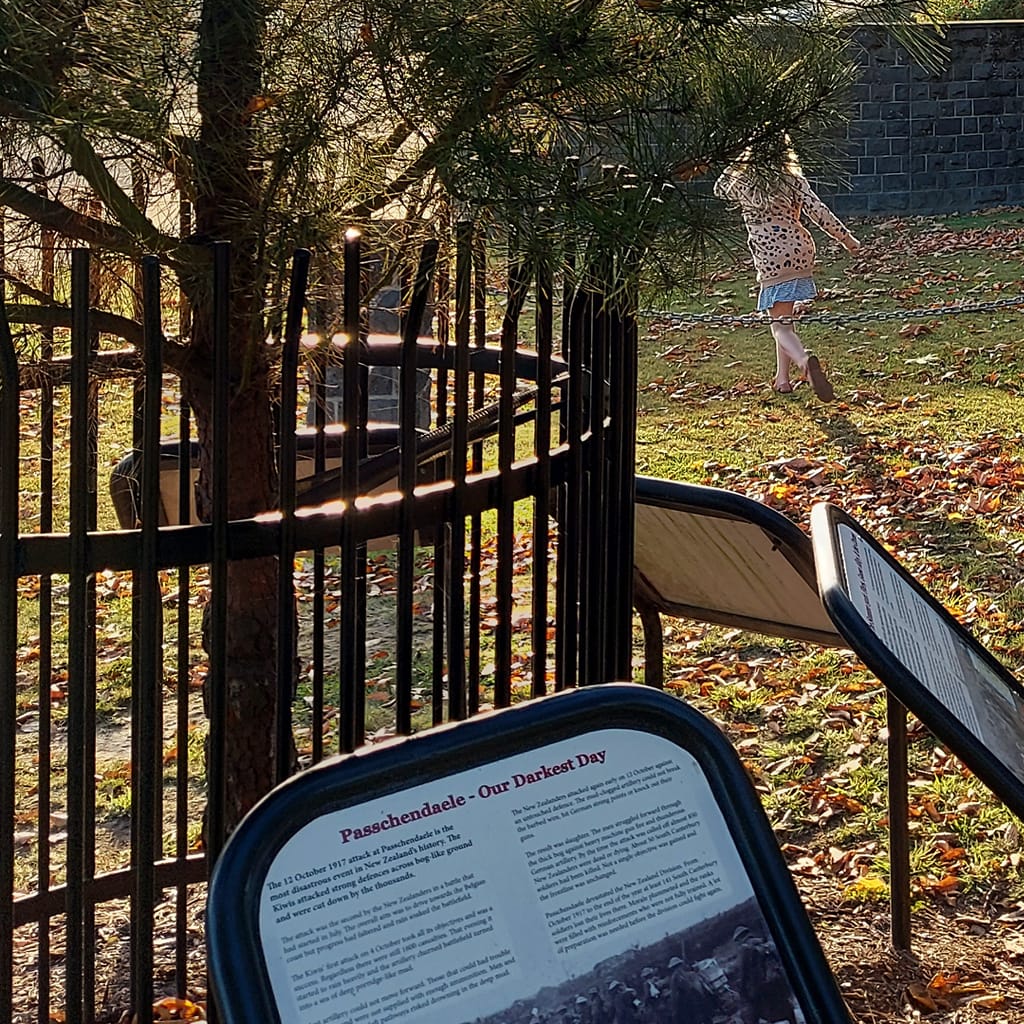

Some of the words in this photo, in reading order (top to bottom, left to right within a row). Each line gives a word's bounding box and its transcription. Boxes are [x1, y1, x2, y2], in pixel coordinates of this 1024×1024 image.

[338, 794, 466, 843] Passchendaele
[476, 782, 511, 799] Our
[512, 760, 575, 788] Darkest
[576, 751, 609, 768] Day
[266, 880, 282, 890] The
[283, 875, 293, 884] 12
[293, 866, 326, 881] October
[328, 858, 346, 870] 1917
[348, 850, 371, 863] attack
[380, 831, 433, 852] Passchendaele
[441, 824, 454, 833] the
[269, 889, 290, 901] most
[290, 876, 331, 894] disastrous
[332, 868, 353, 880] event
[354, 865, 363, 873] in
[363, 860, 381, 869] New
[447, 833, 461, 842] The
[272, 899, 295, 912] Kiwis
[297, 886, 330, 903] attacked
[331, 879, 356, 892] strong
[356, 868, 389, 883] defences
[390, 860, 414, 872] across
[446, 838, 472, 855] ground
[275, 911, 291, 923] and
[292, 907, 311, 917] were
[312, 901, 325, 910] cut
[326, 894, 349, 906] down
[349, 890, 360, 898] by
[360, 885, 373, 894] the
